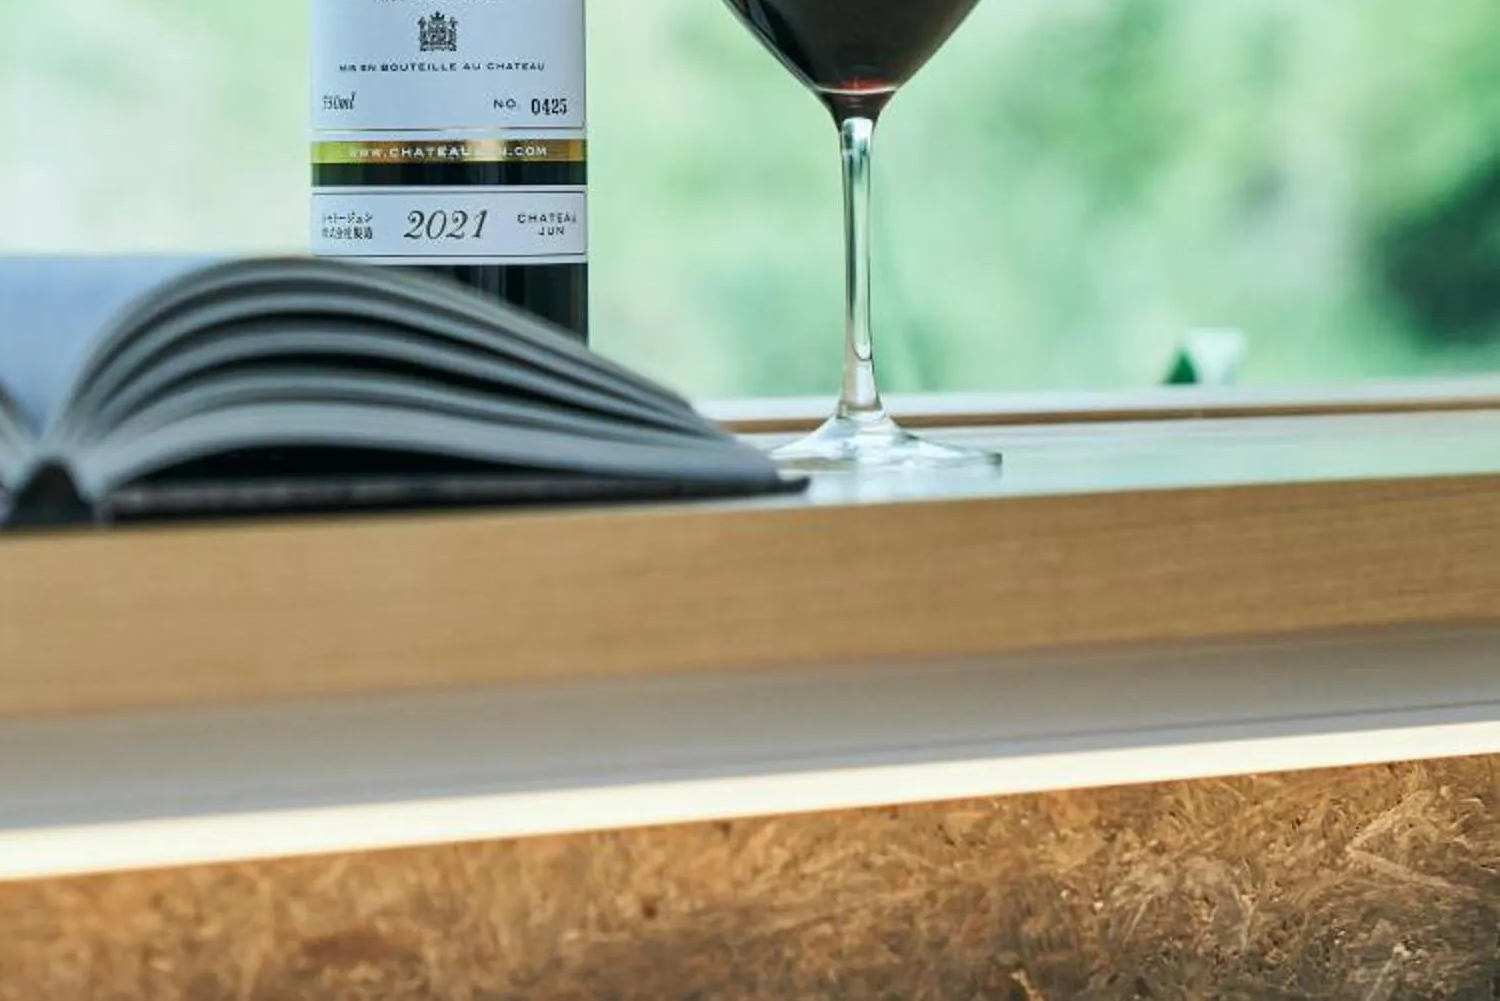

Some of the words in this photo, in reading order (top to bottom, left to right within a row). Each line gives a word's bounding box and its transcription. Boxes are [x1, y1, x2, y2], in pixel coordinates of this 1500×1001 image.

[379, 62, 457, 72] BOUTEILLE
[463, 62, 481, 71] AU
[486, 61, 546, 72] CHATEAU
[530, 97, 568, 116] 0425
[403, 209, 489, 240] 2021
[537, 226, 566, 237] JUN
